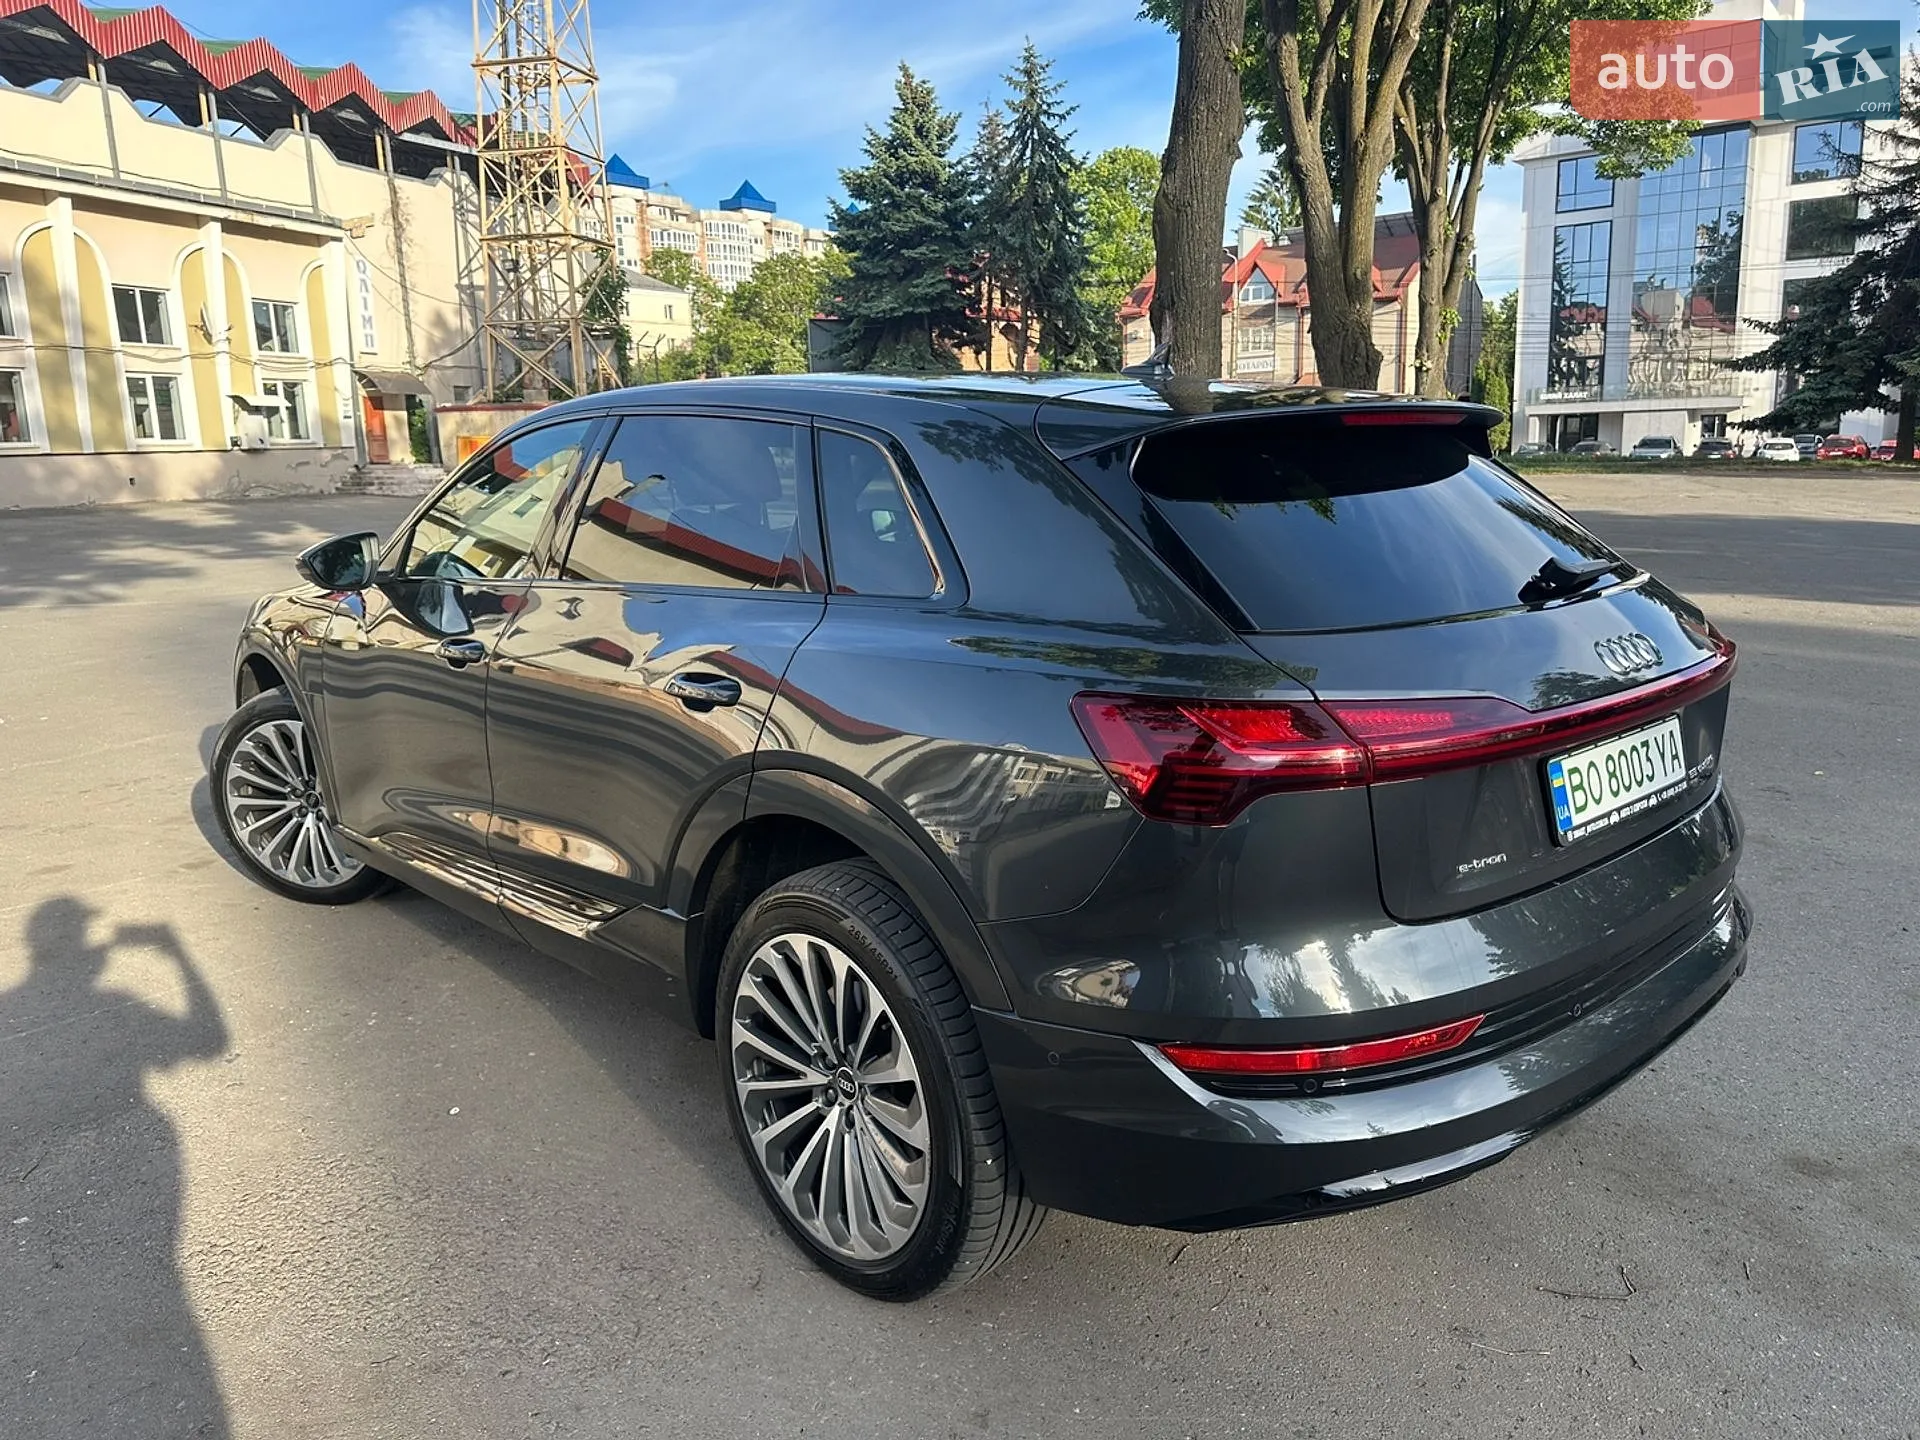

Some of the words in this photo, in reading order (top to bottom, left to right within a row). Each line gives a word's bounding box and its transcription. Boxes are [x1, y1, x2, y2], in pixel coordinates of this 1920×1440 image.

[1567, 759, 1603, 815] BO
[1605, 739, 1655, 798] 8003
[1654, 729, 1681, 777] YA
[1557, 803, 1572, 820] UA
[1458, 852, 1507, 873] e-tron
